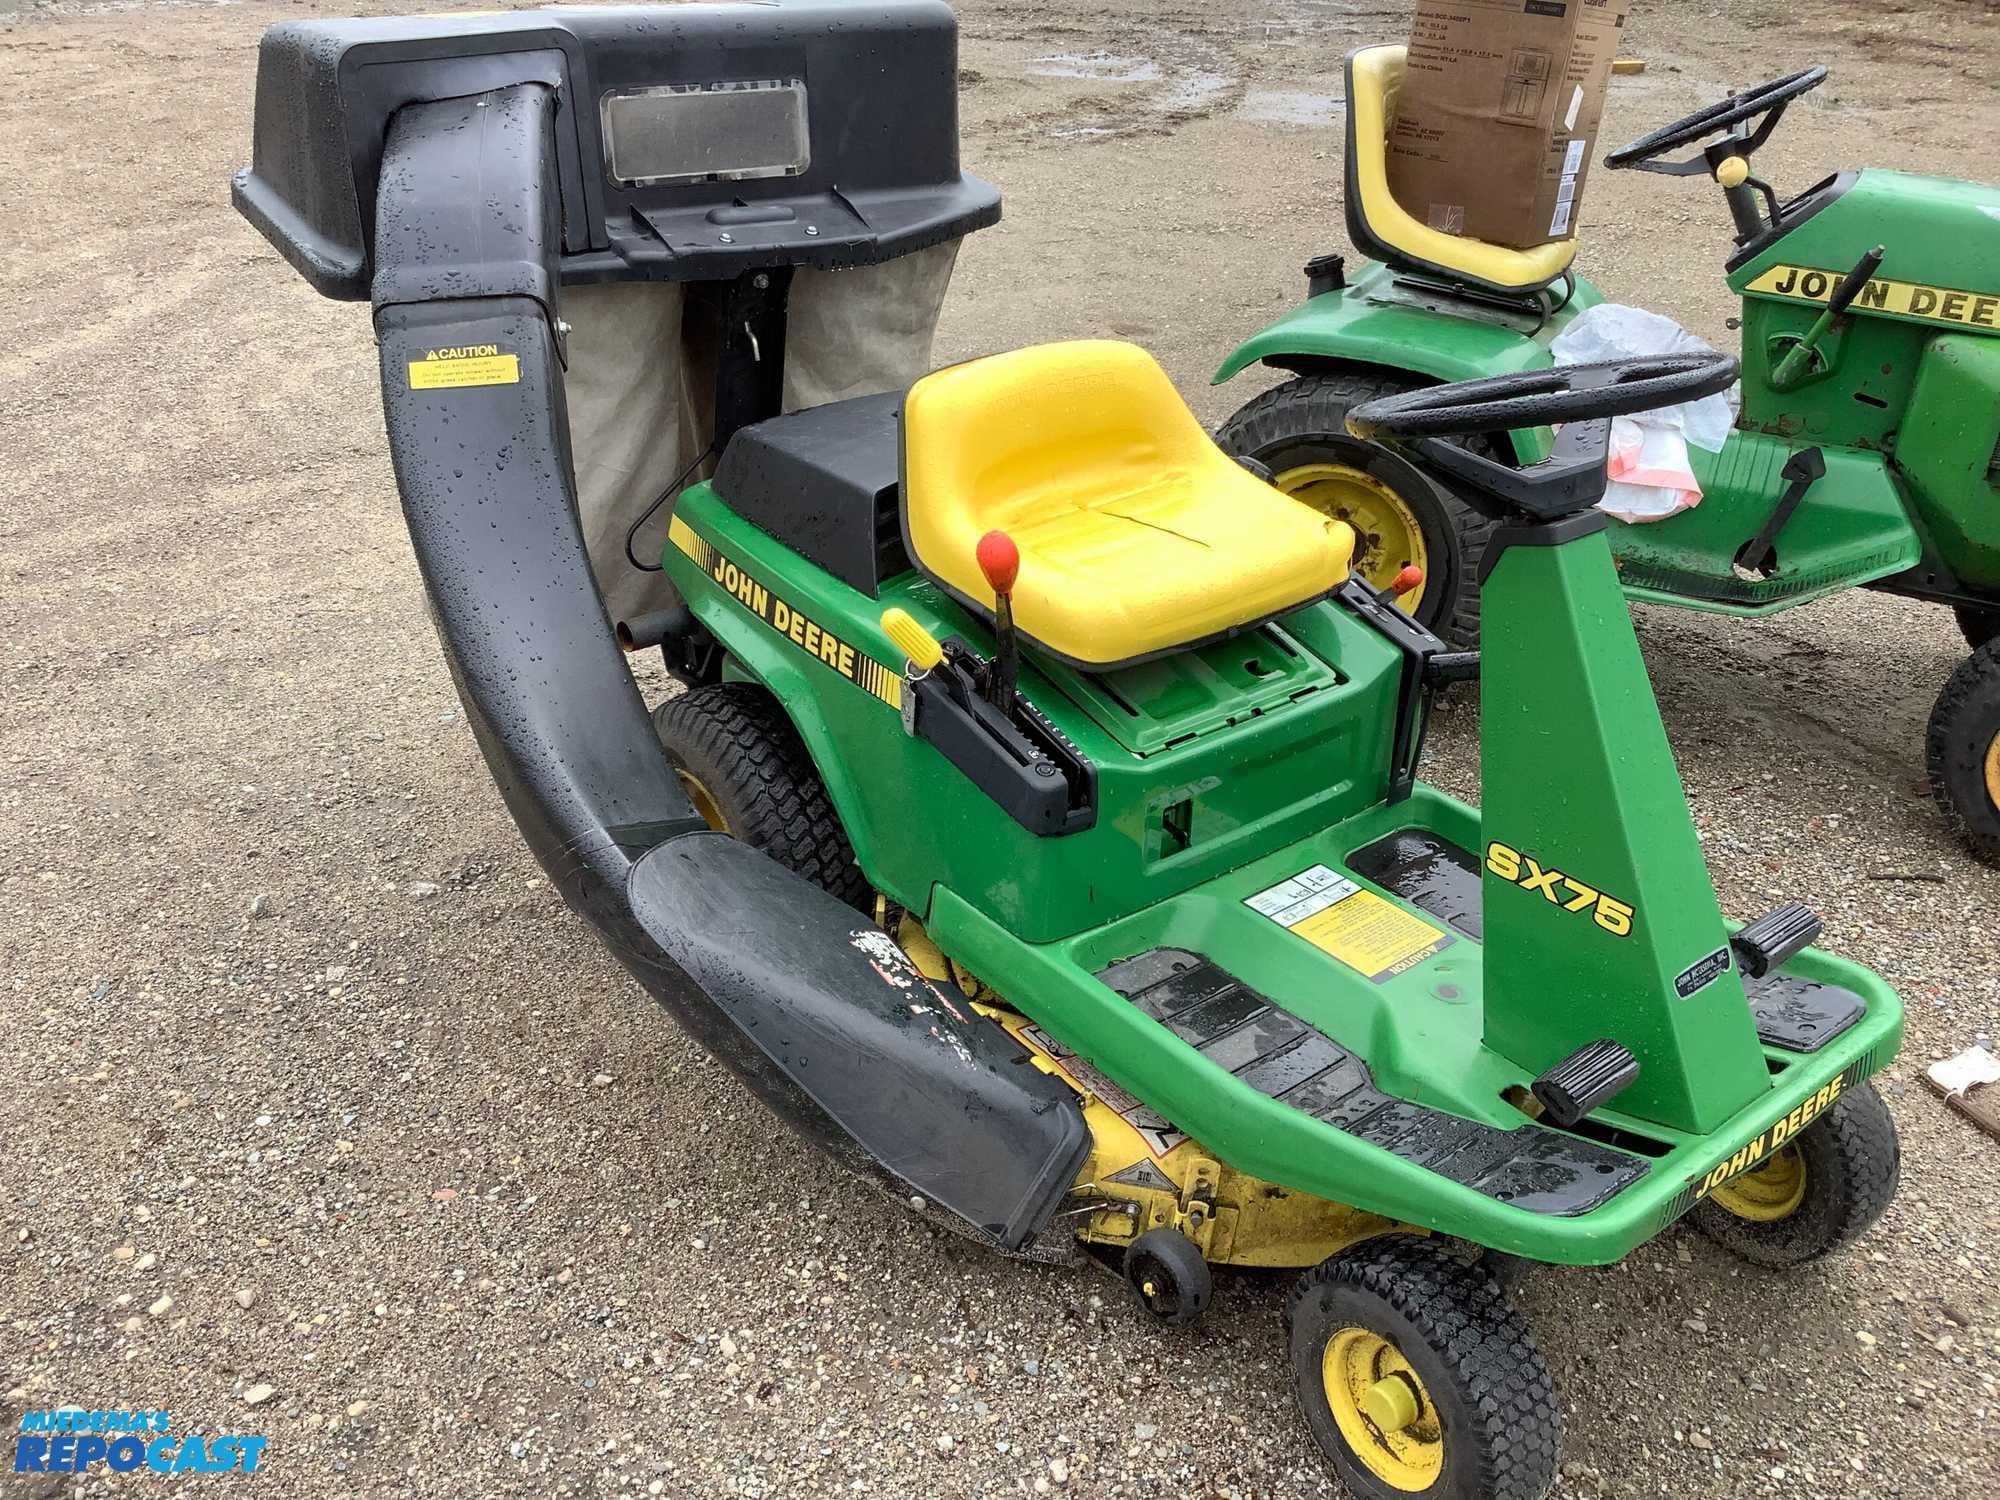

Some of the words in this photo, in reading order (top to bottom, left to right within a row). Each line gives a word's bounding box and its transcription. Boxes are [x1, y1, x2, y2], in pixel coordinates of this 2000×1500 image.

[1775, 269, 1890, 309] JON
[438, 344, 498, 360] CAUTION
[714, 556, 768, 618] JOHN
[774, 599, 854, 678] DEERE
[1485, 841, 1636, 937] SX75
[1388, 949, 1431, 975] CAUTION
[1696, 1134, 1765, 1199] JOHN
[1771, 1074, 1844, 1148] DEERE
